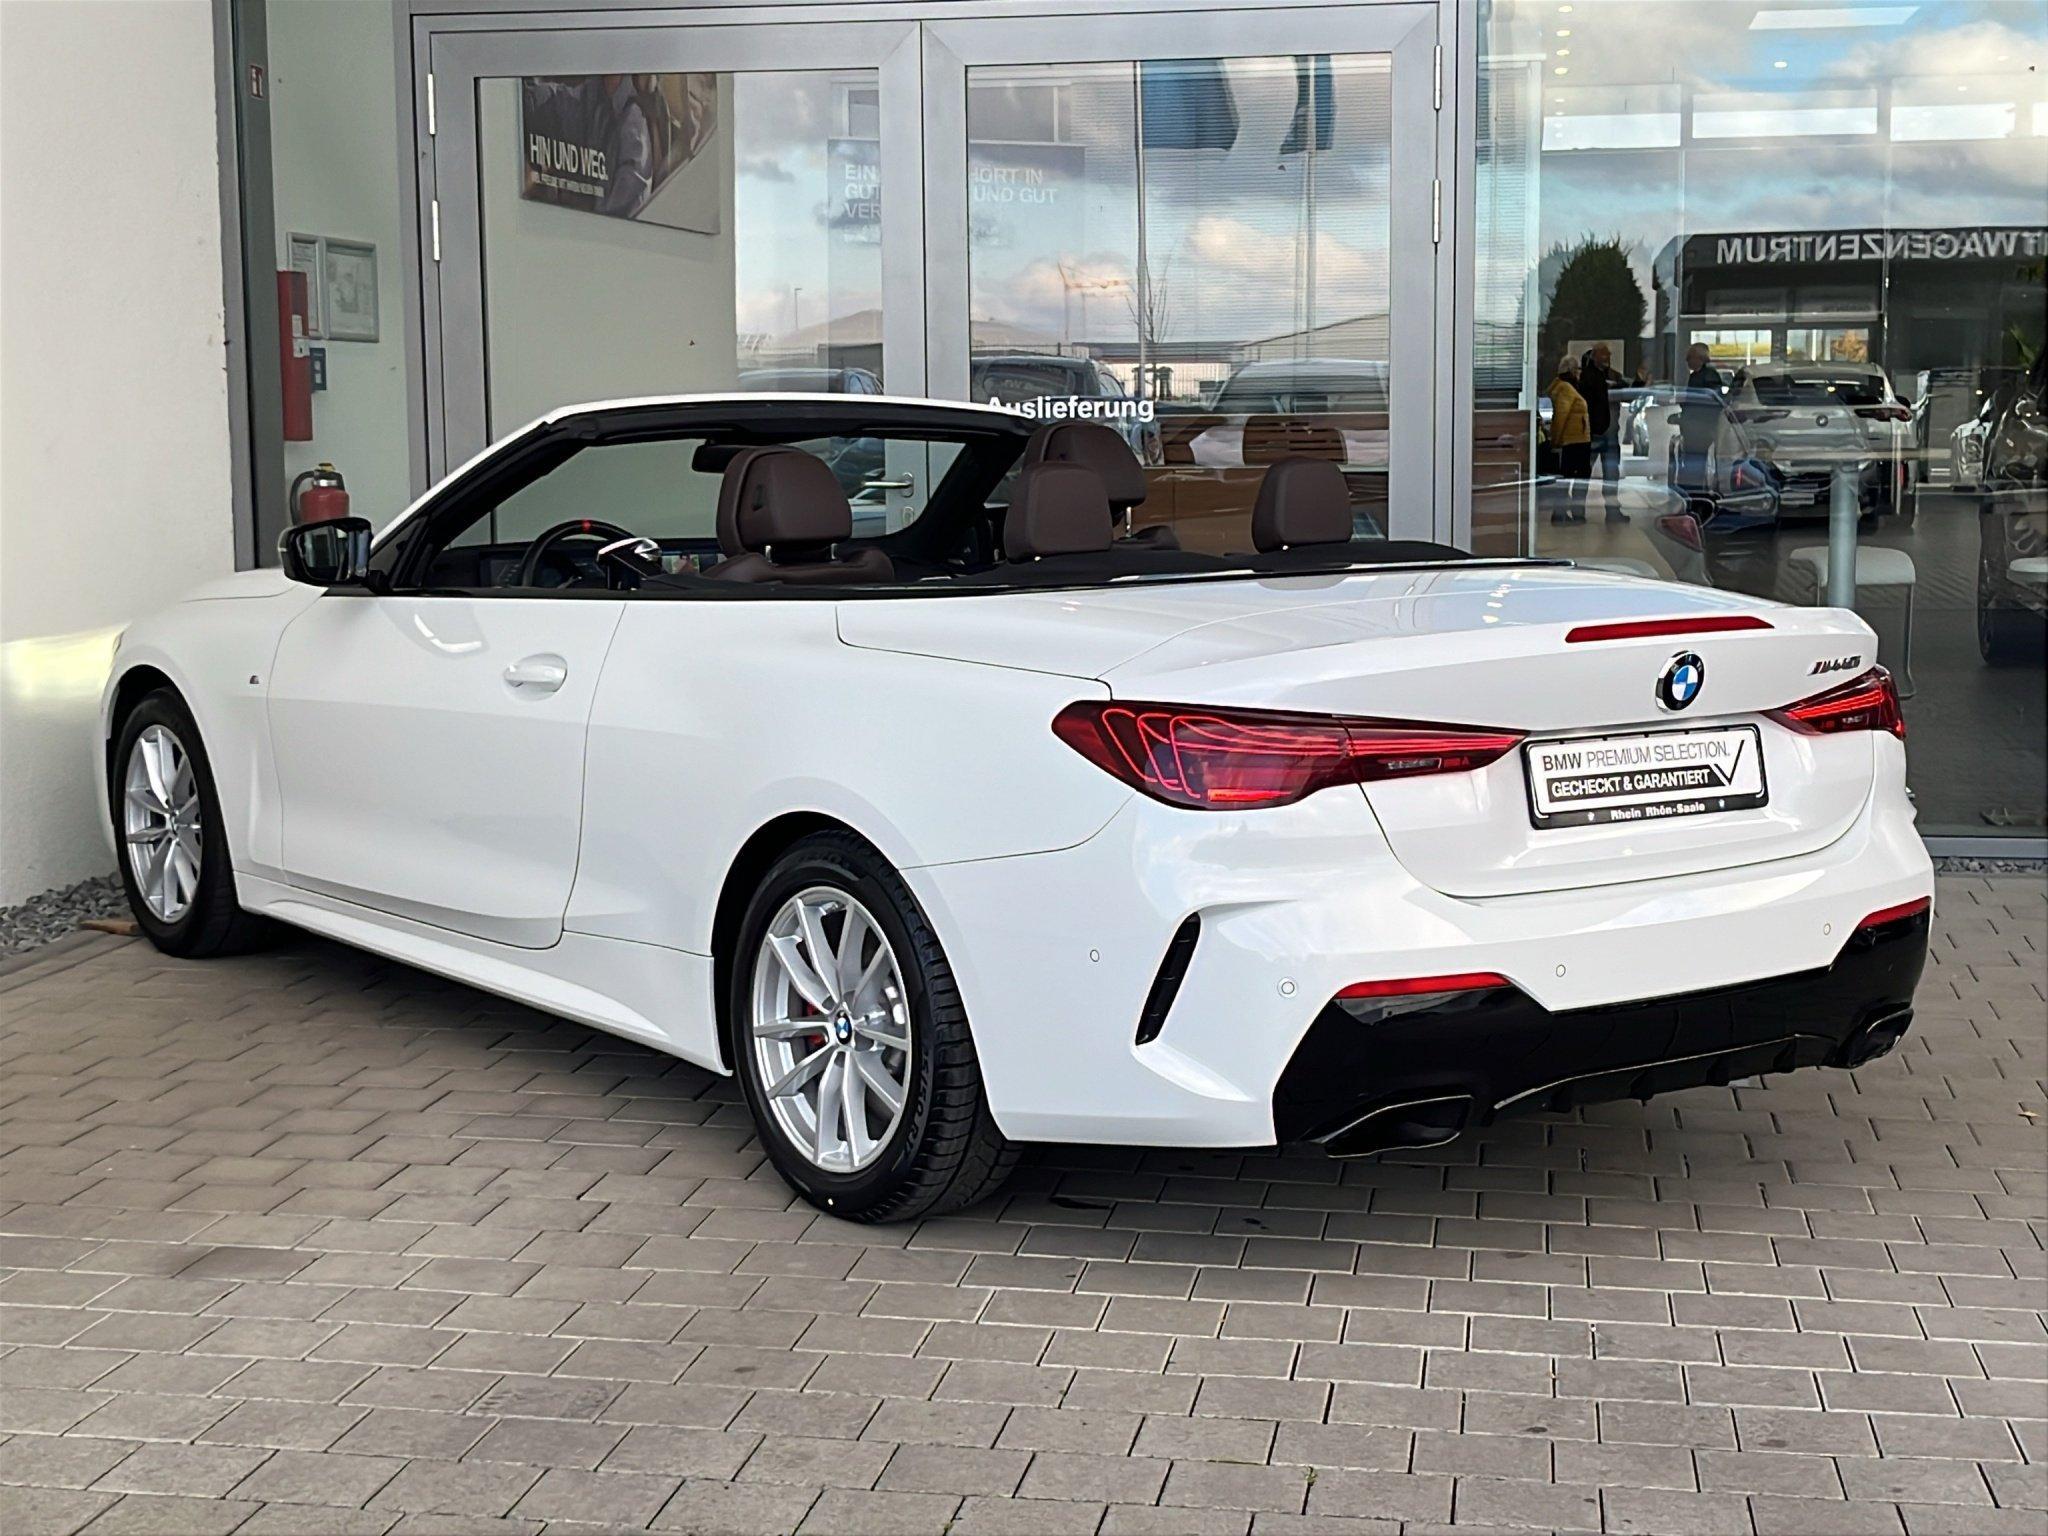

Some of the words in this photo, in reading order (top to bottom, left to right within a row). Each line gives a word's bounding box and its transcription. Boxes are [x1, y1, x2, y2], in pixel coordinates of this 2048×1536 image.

[530, 133, 551, 169] HIN
[553, 139, 579, 173] UND
[845, 164, 876, 183] EIN
[1025, 168, 1043, 185] IN
[974, 187, 1013, 203] UND
[1020, 188, 1058, 204] GUT
[1543, 752, 1582, 771] BMW
[1586, 747, 1652, 768] PREMIUM
[1654, 741, 1731, 762] SELECTION.
[1551, 777, 1622, 797] GECHECKT
[1623, 775, 1633, 791] &
[1633, 769, 1711, 790] GARANTIERT
[1610, 807, 1642, 821] Rhein
